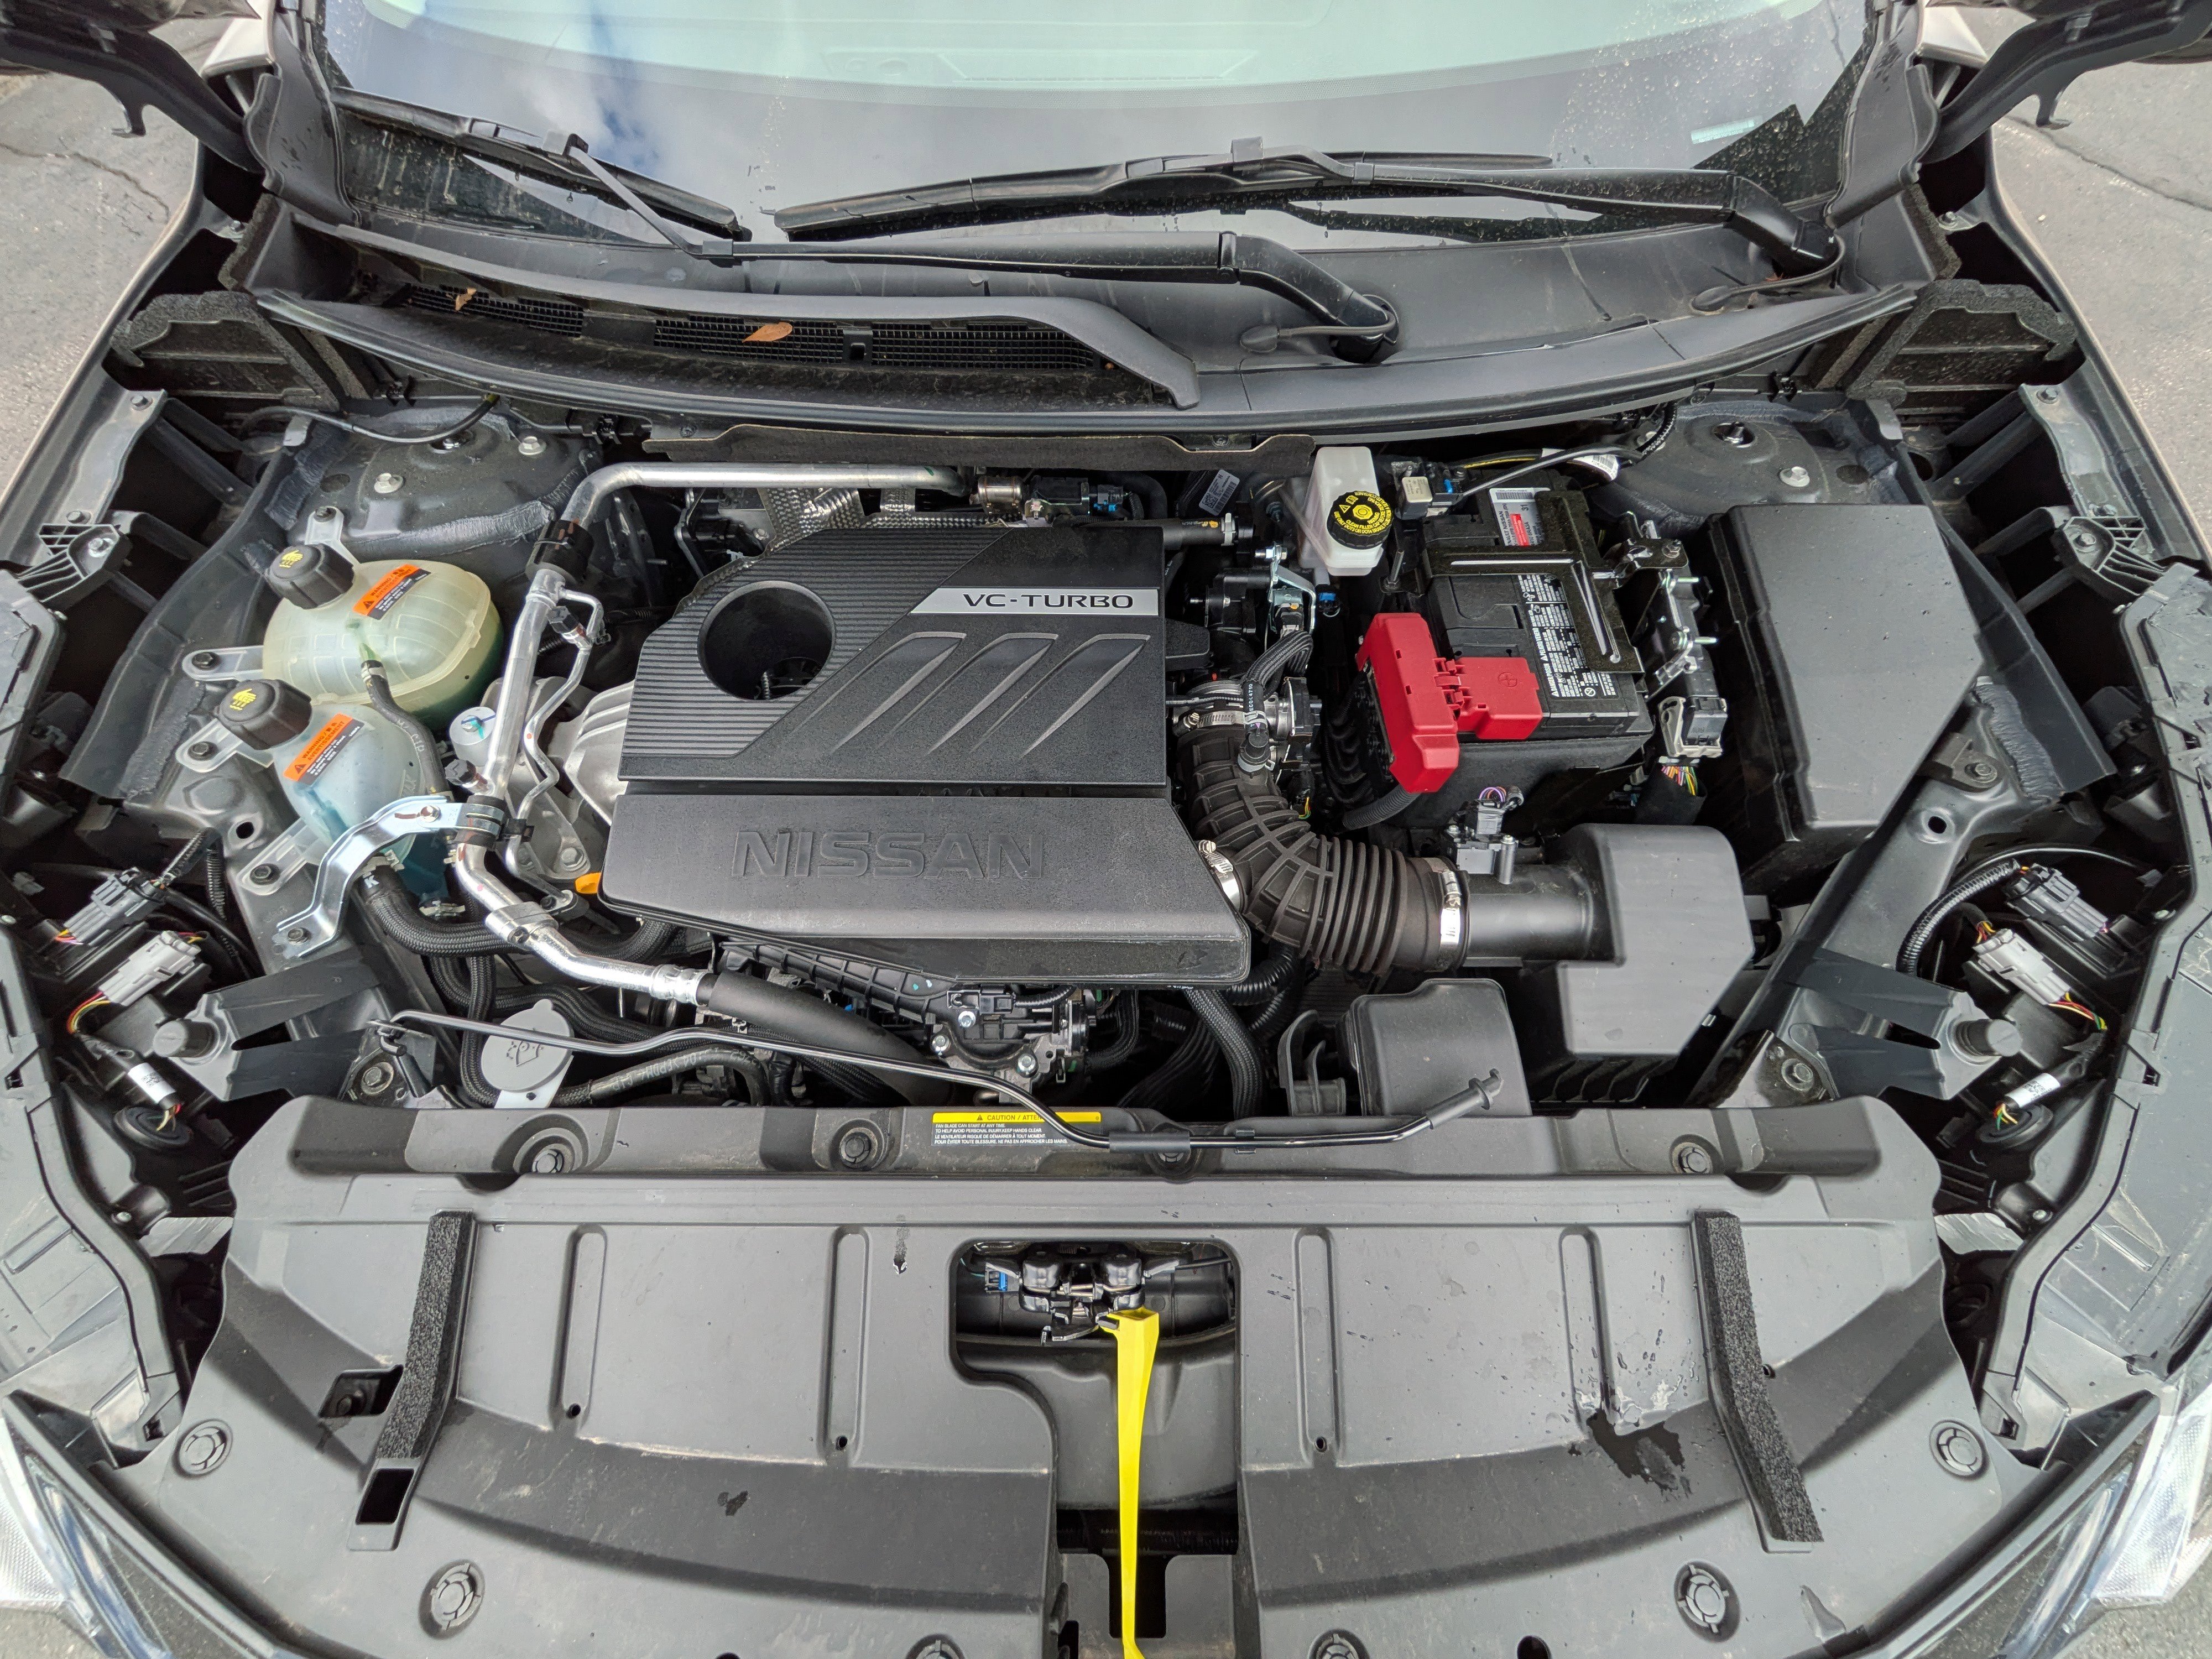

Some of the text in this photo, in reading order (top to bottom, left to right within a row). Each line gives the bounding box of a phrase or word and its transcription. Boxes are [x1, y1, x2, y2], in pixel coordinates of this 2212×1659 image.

[1346, 520, 1359, 528] CLEAN
[1499, 510, 1507, 530] NISSAN
[963, 593, 1134, 608] VC-TURBO
[302, 735, 324, 759] WARNING
[731, 830, 1044, 879] NISSAN
[364, 875, 379, 888] K
